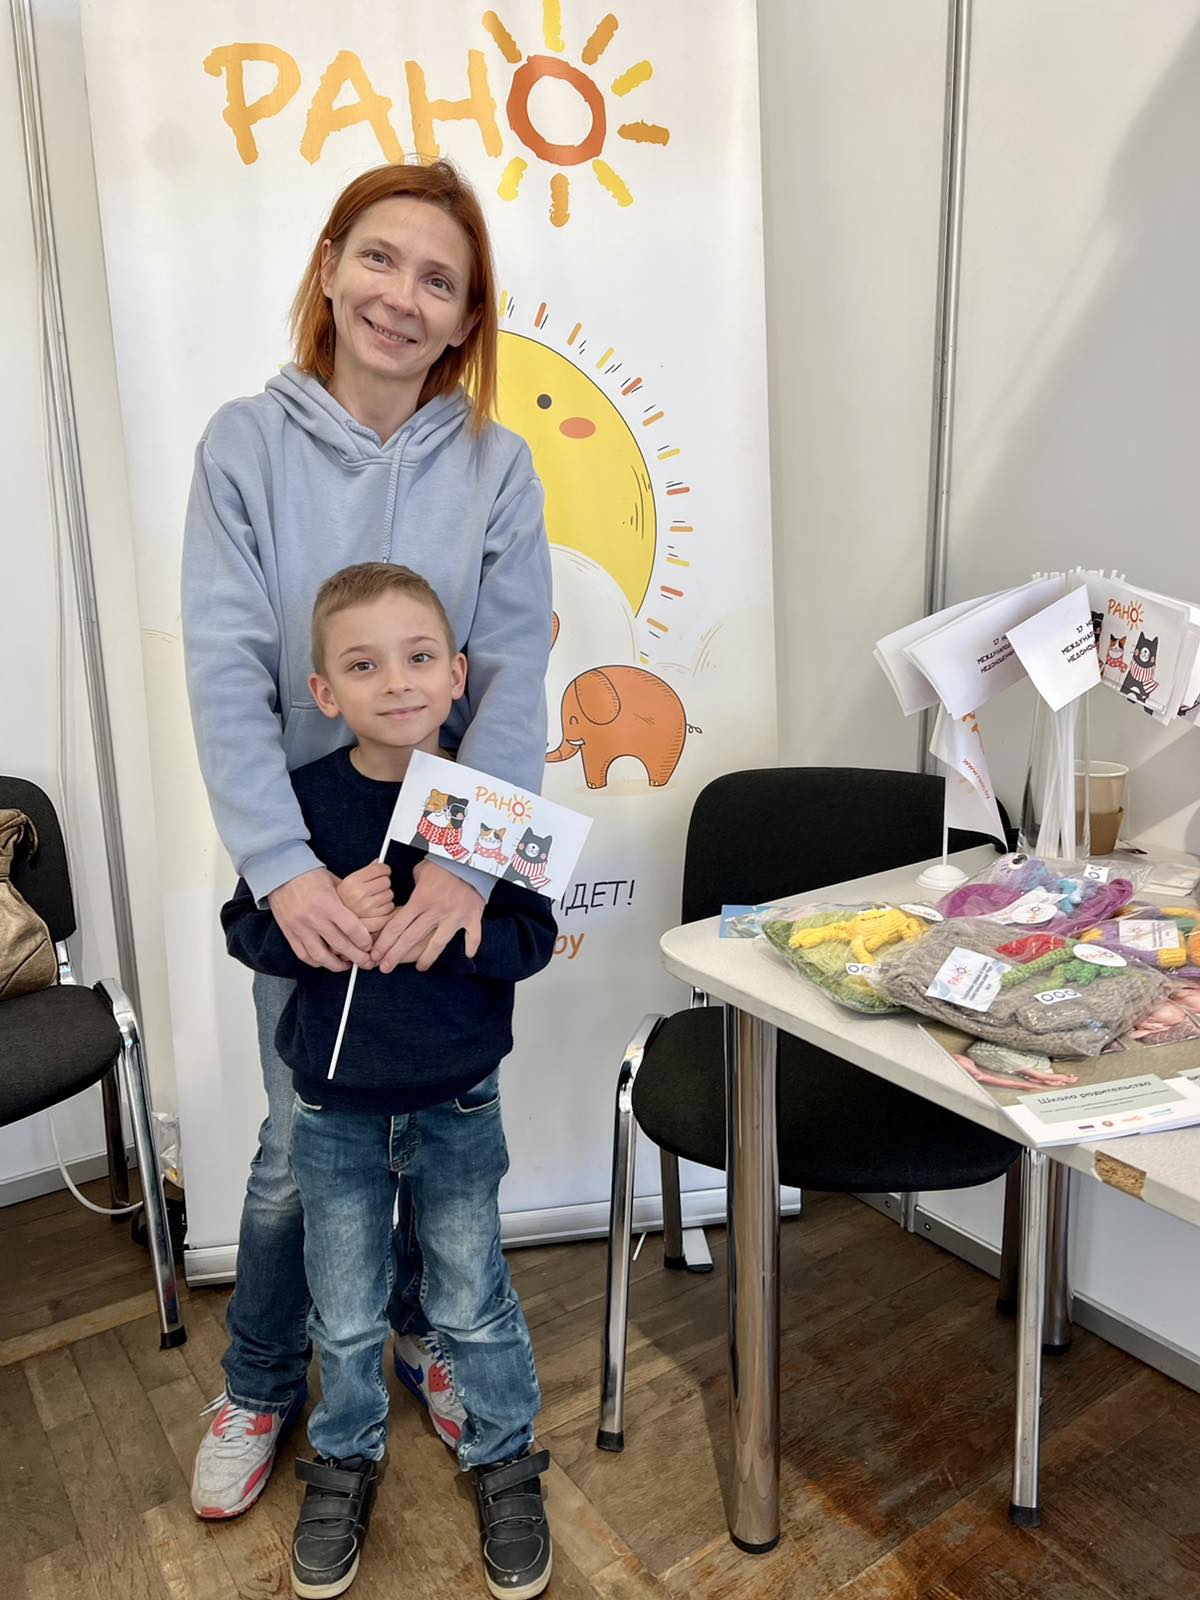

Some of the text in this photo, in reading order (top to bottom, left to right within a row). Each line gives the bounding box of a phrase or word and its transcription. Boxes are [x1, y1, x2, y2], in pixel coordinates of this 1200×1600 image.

[202, 42, 607, 166] РАНО
[1107, 598, 1139, 623] РАНО
[475, 785, 526, 818] РАНО
